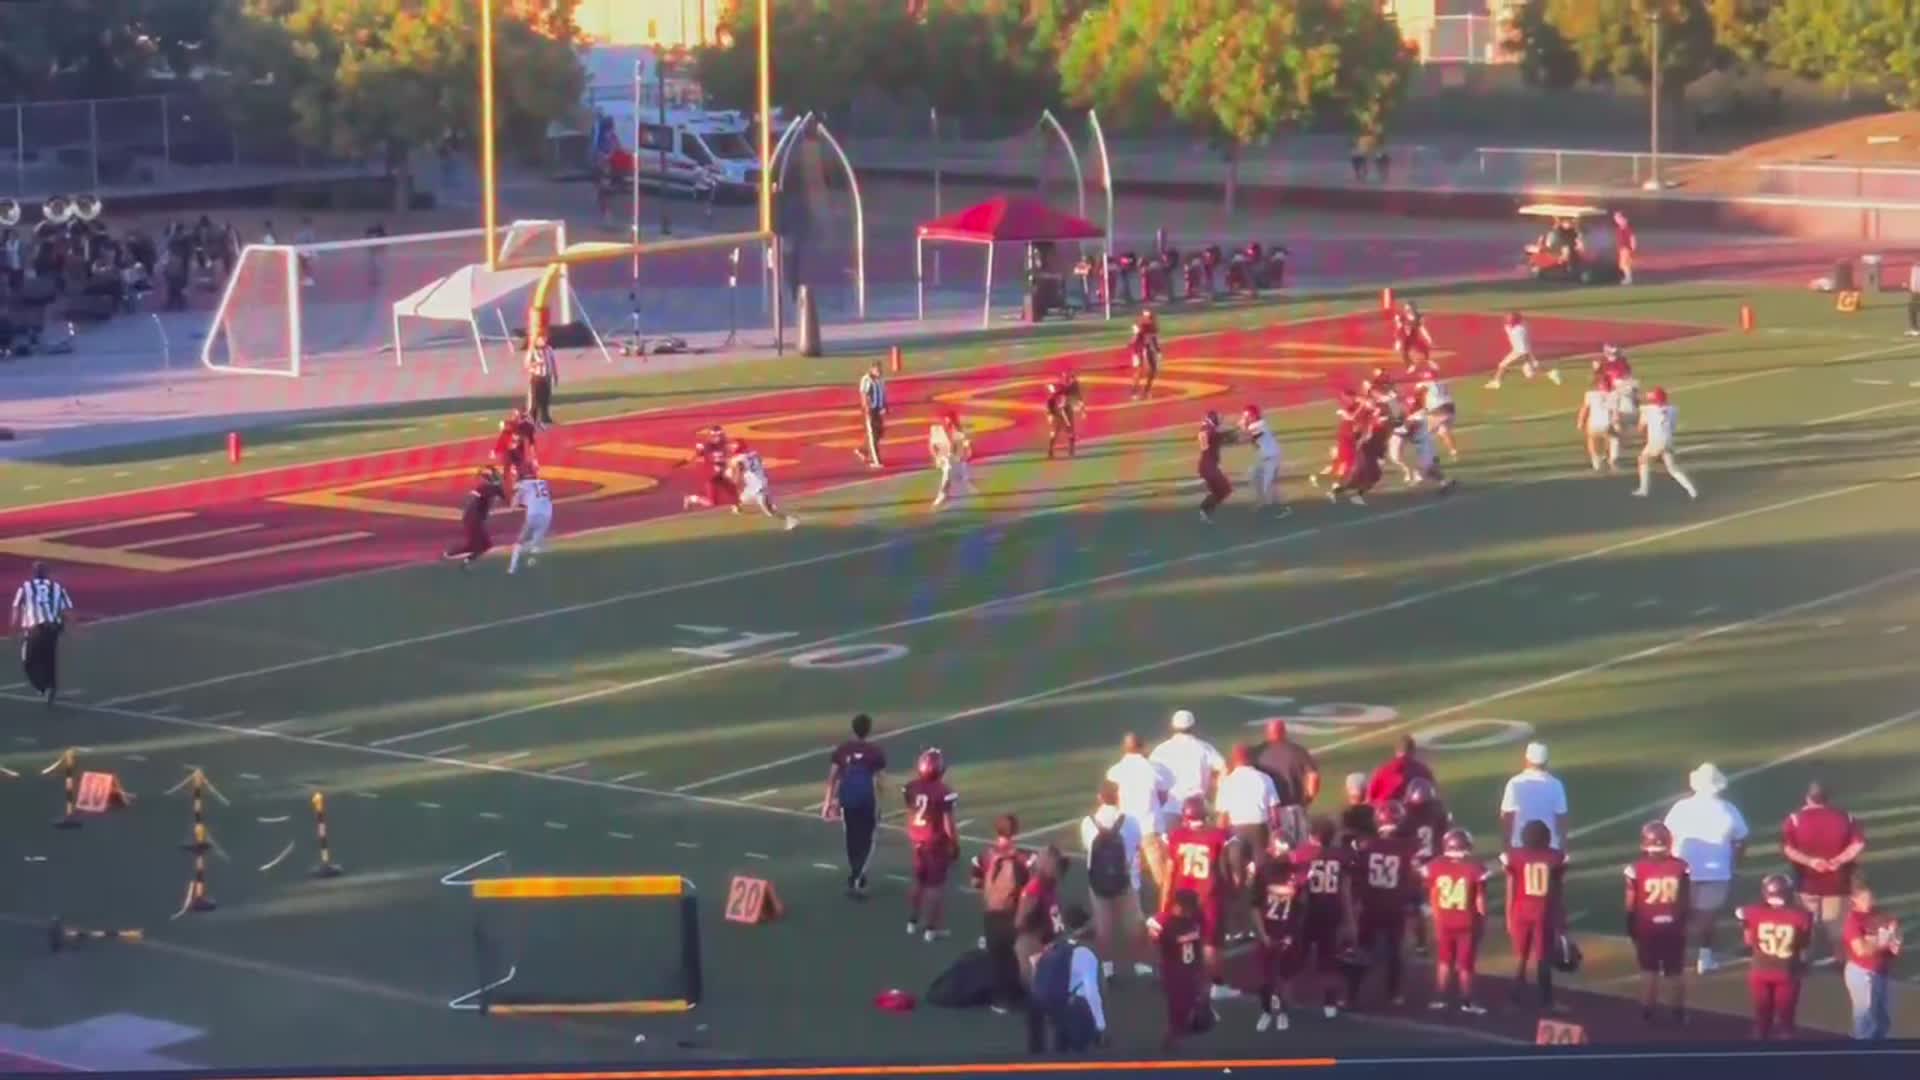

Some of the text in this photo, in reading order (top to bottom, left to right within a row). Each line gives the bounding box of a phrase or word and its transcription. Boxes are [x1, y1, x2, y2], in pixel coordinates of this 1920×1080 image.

[915, 794, 928, 827] 2
[1368, 853, 1400, 888] 53
[731, 880, 761, 917] 20
[1758, 923, 1794, 959] 52
